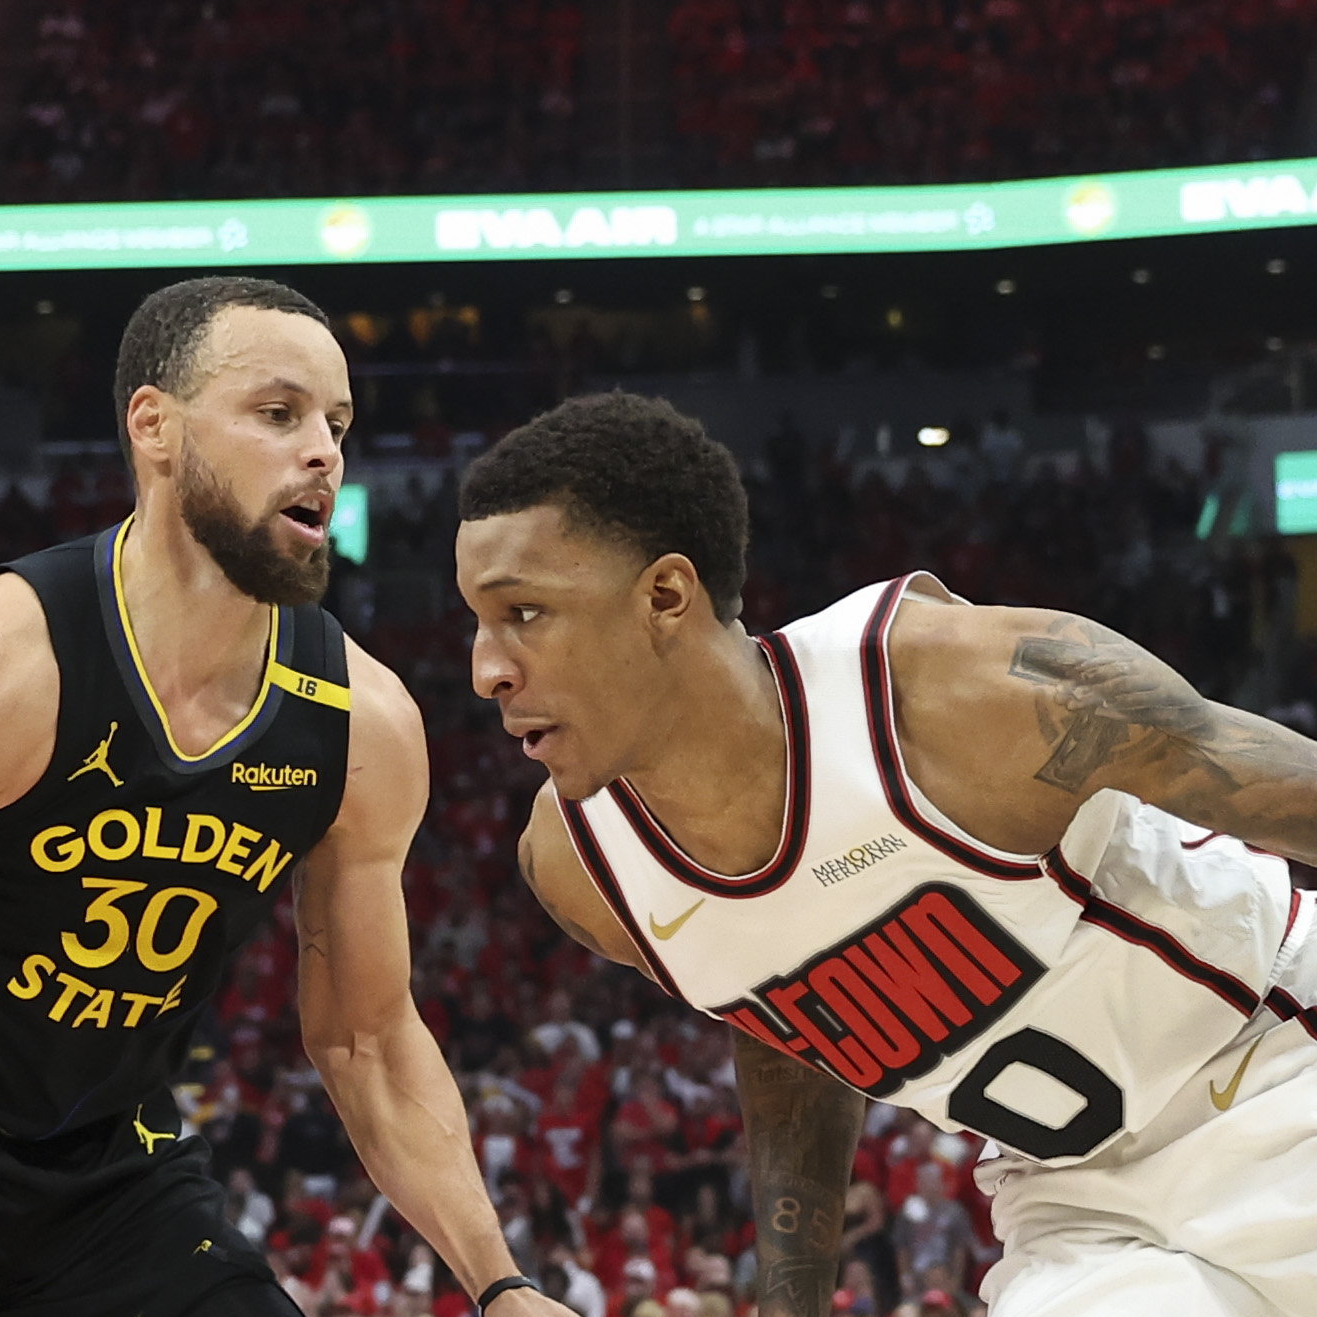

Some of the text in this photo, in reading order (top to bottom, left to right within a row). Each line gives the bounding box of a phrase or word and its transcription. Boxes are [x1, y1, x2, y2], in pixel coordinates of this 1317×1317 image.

[296, 677, 317, 697] 16
[232, 763, 317, 788] Rakuten
[31, 807, 293, 892] GOLDEN
[812, 834, 899, 876] MEMORIAL
[817, 839, 907, 887] HERMANN
[61, 877, 219, 972] 30
[949, 1026, 1124, 1160] 0
